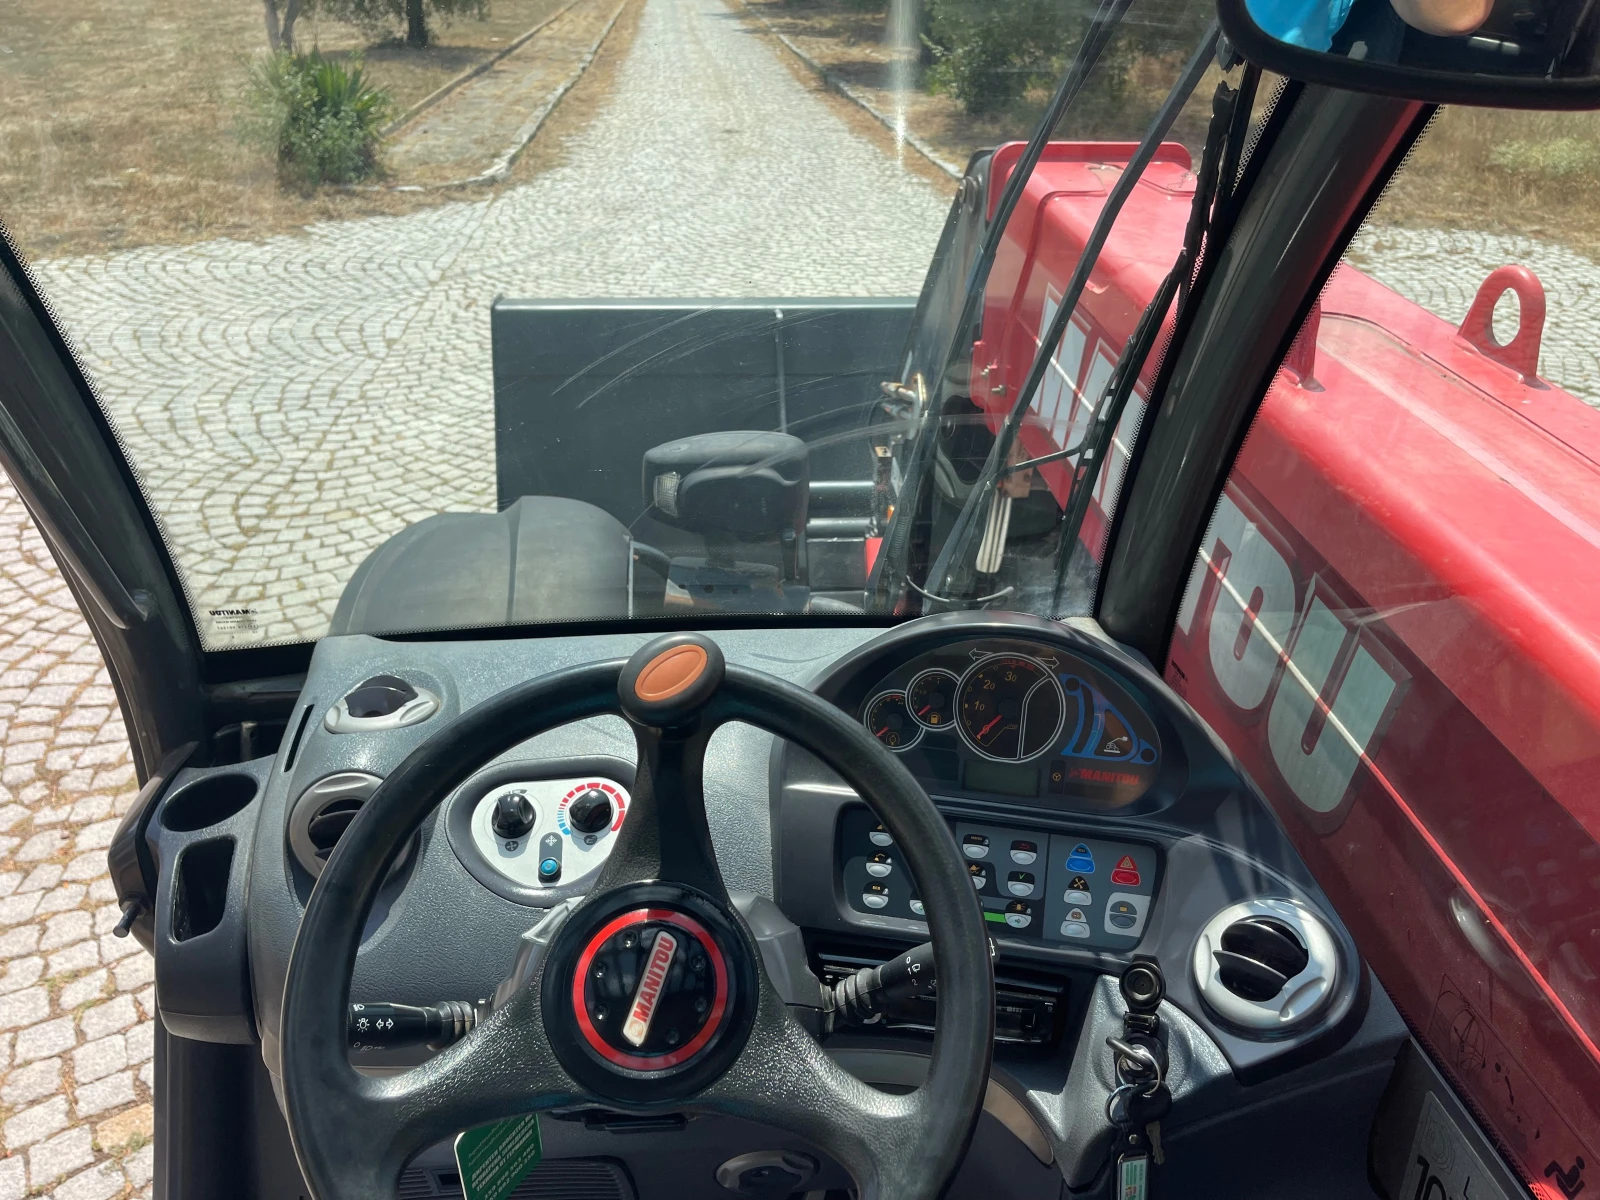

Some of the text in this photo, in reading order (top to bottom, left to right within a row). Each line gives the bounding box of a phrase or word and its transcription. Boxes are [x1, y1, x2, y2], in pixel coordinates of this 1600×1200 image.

[1004, 671, 1017, 681] 30
[983, 680, 995, 690] 20
[974, 701, 985, 711] 10
[1079, 768, 1140, 785] MANITOU
[632, 936, 674, 1023] MANITOU
